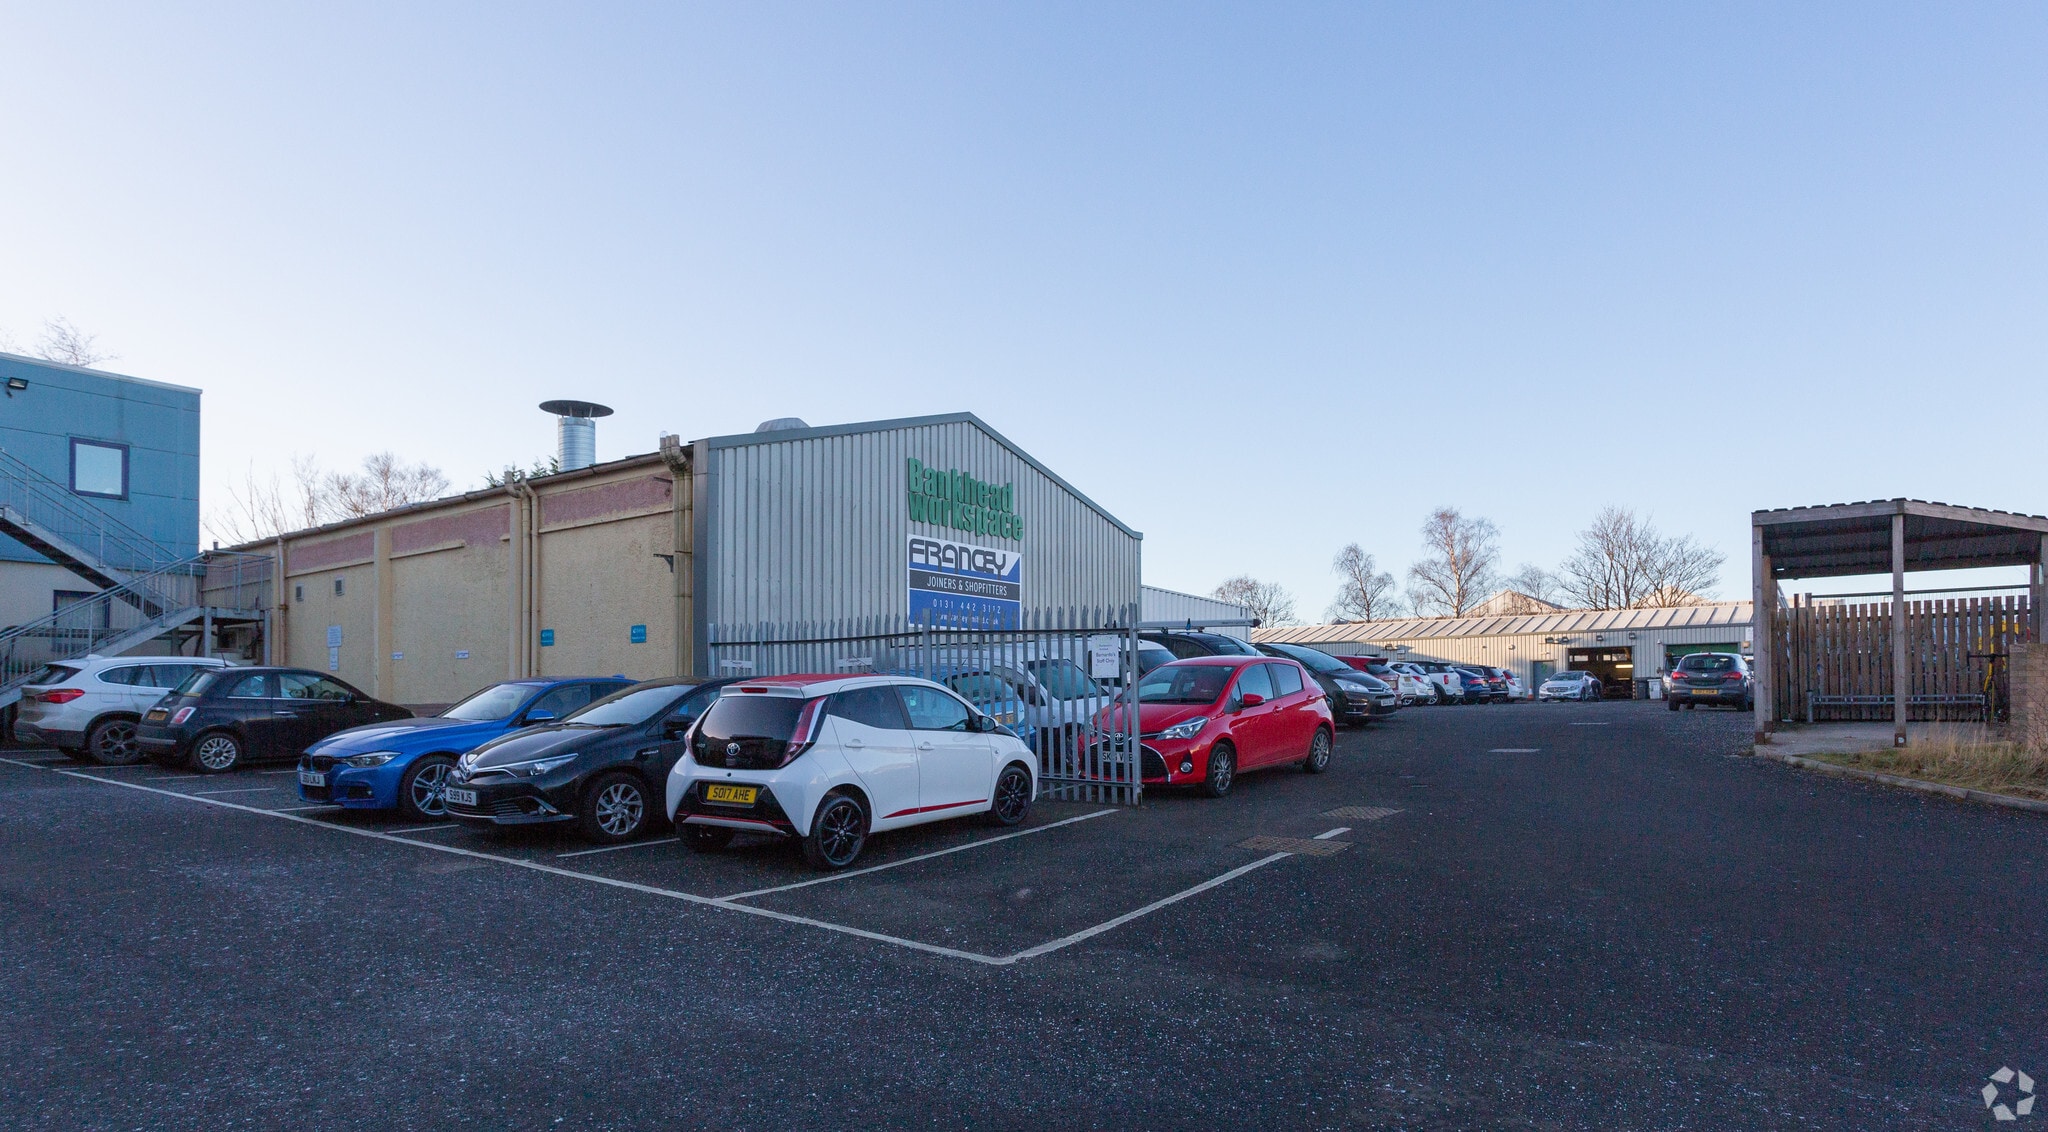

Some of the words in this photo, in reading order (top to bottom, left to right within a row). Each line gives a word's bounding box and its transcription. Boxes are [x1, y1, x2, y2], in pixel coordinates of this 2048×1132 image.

[908, 457, 1014, 514] Bankhead
[908, 538, 1007, 580] FRANCEY
[926, 576, 957, 591] JOINERS
[958, 580, 964, 591] &
[964, 580, 1008, 597] SHOPFITTERS
[933, 598, 954, 609] 0131
[960, 602, 976, 613] 442
[712, 787, 732, 801] SO17
[733, 788, 751, 801] AHE
